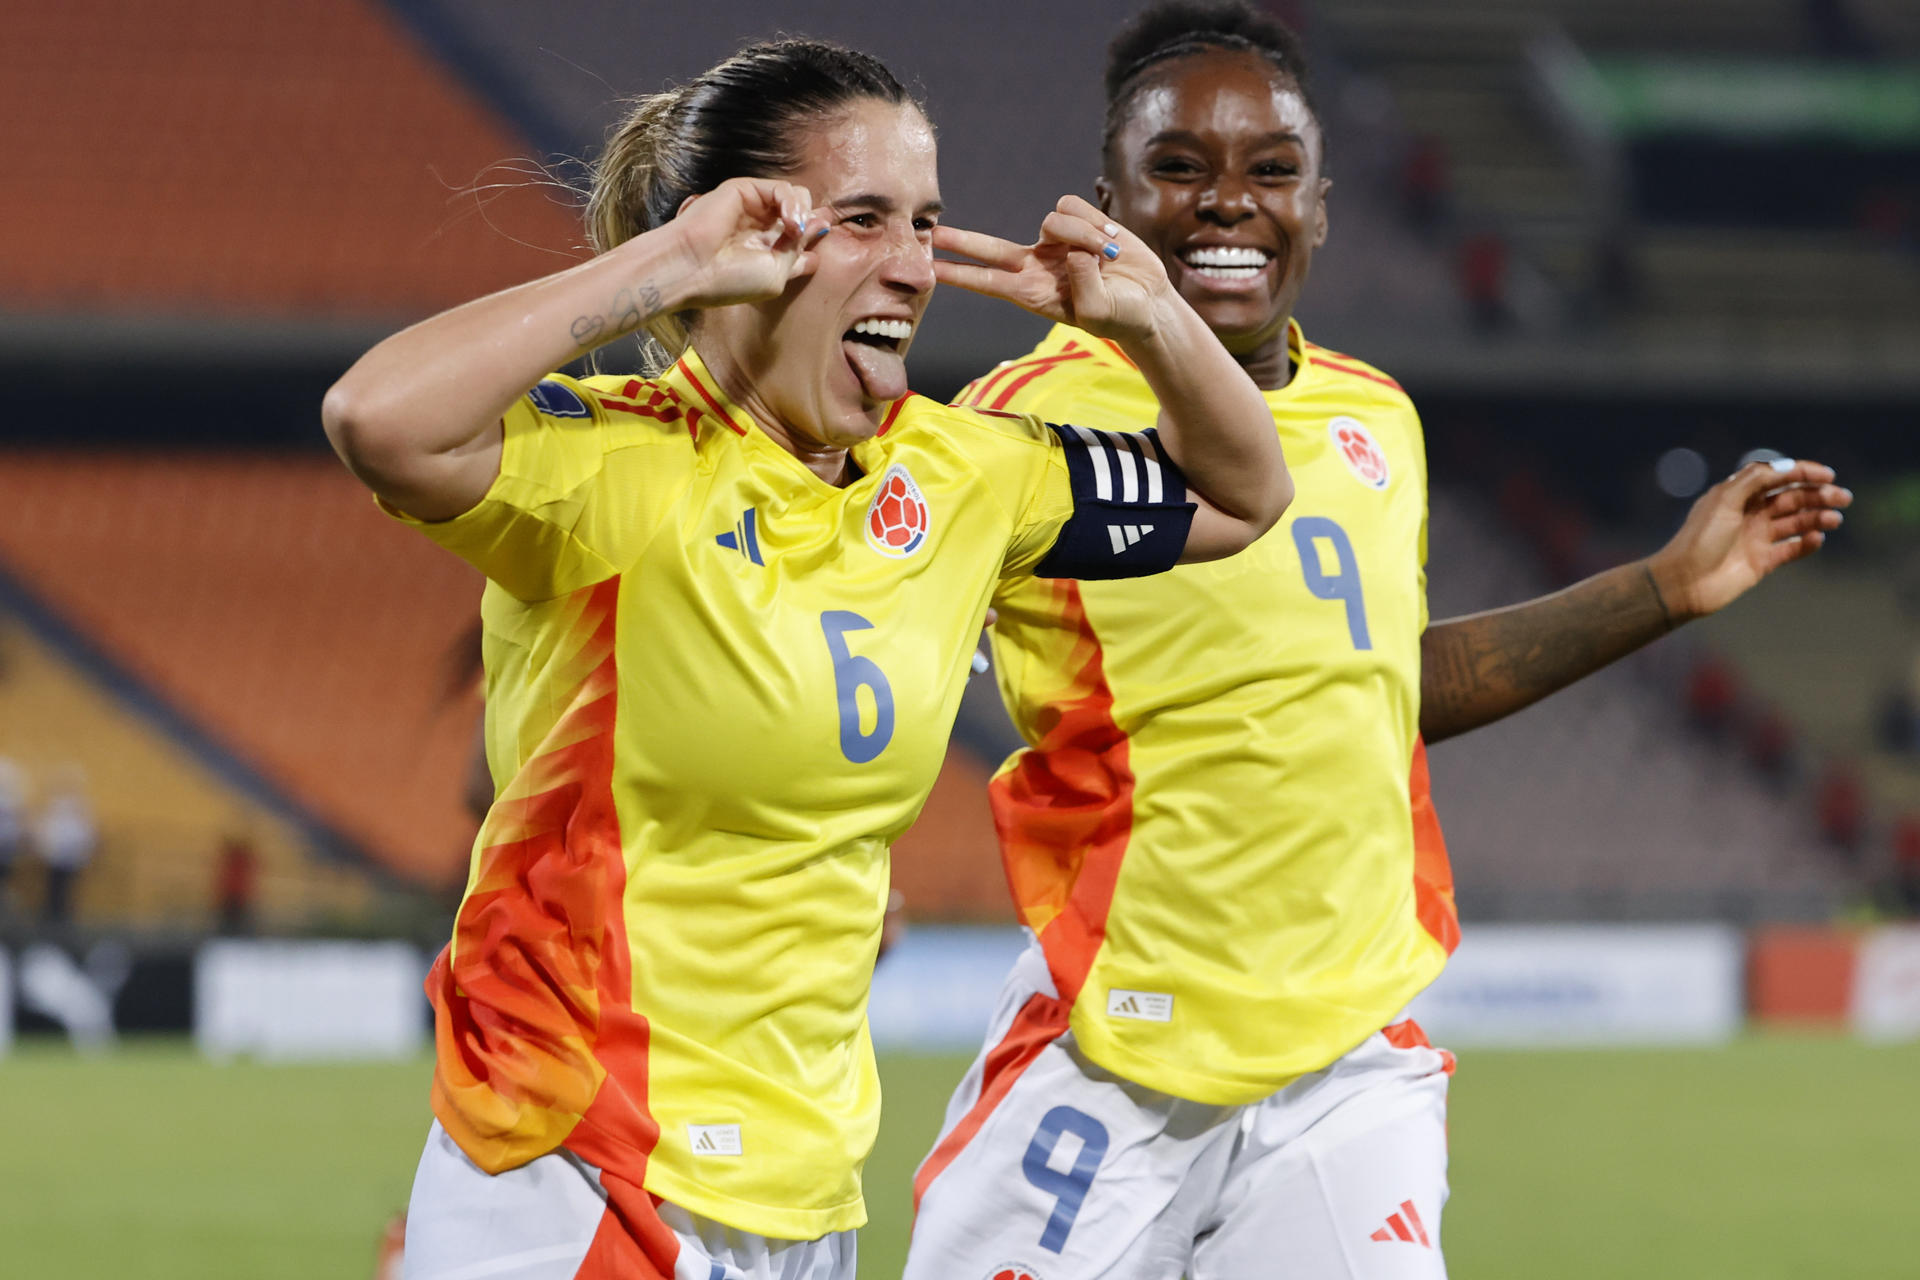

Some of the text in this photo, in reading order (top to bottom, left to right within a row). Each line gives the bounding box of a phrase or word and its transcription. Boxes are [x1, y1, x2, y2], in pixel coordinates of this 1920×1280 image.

[1291, 516, 1373, 650] 9
[820, 610, 895, 764] 6
[1022, 1105, 1109, 1255] 9
